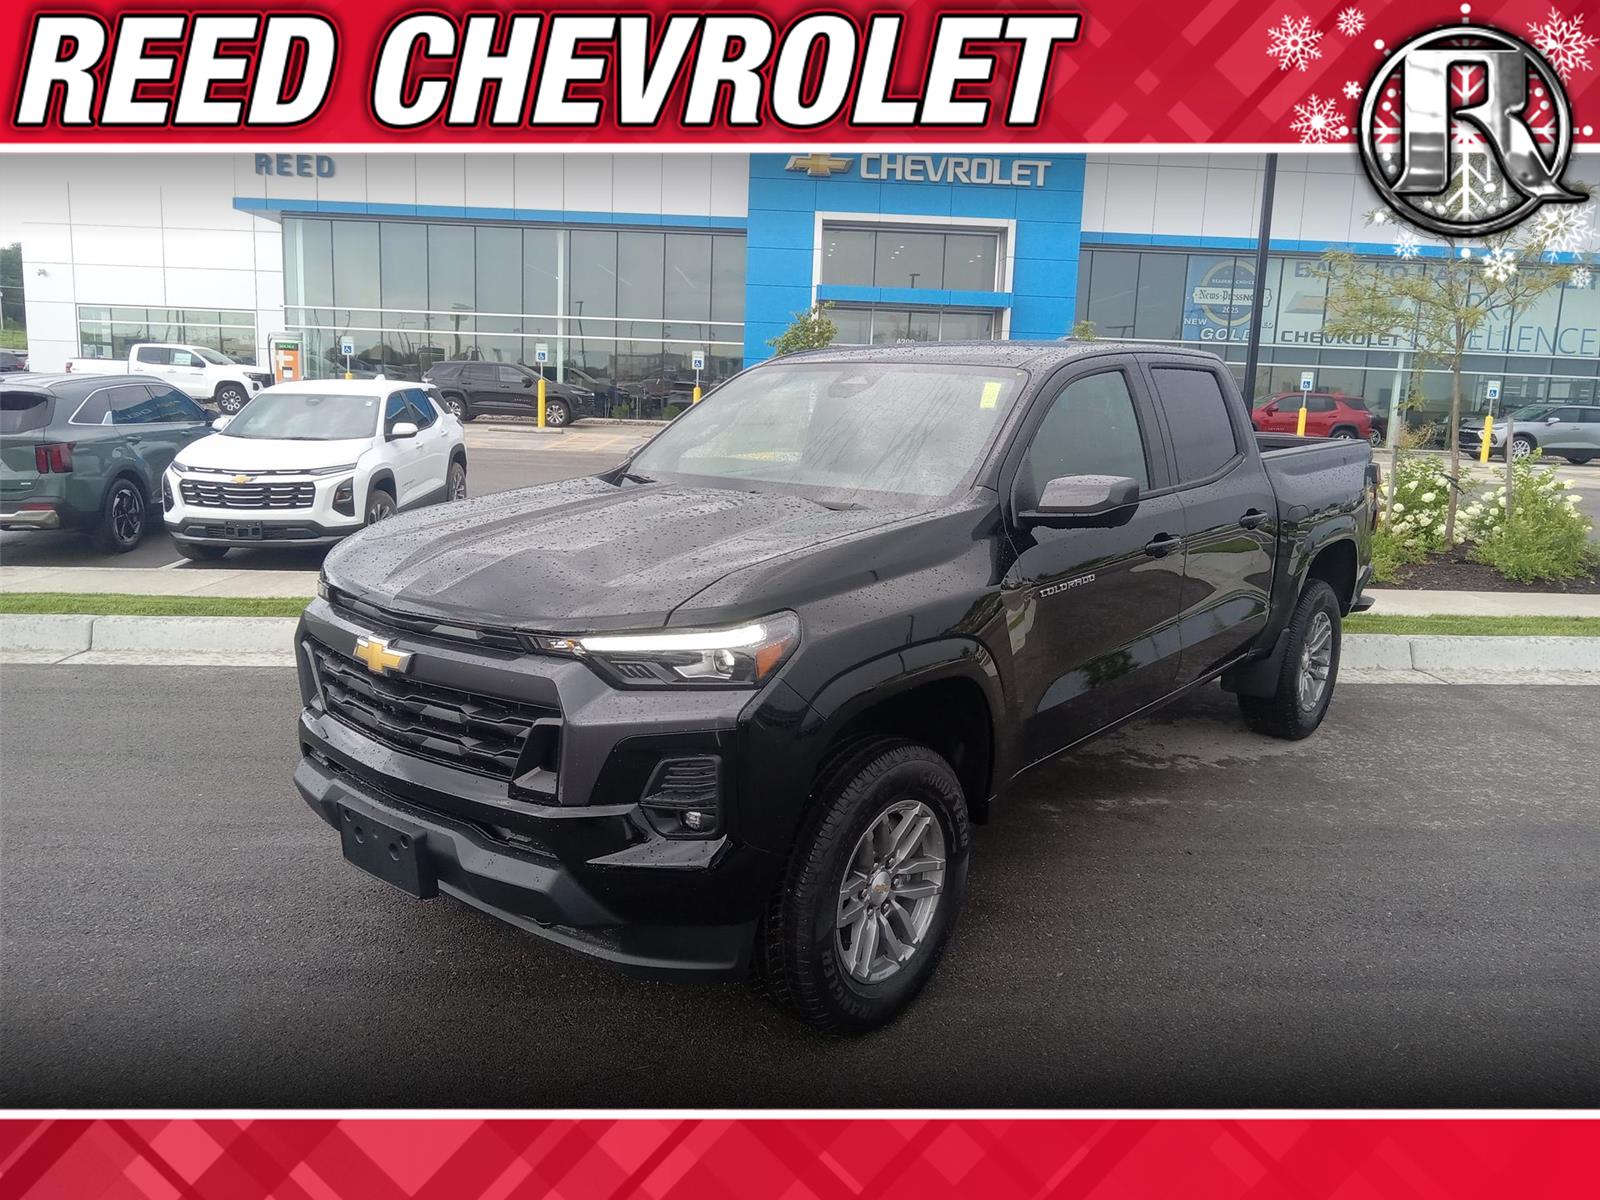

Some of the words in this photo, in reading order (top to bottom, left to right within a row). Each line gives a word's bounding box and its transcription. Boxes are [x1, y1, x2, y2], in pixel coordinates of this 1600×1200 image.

[254, 152, 336, 178] REED
[860, 153, 1052, 187] CHEVROLET
[1183, 317, 1208, 326] NEW
[1280, 329, 1400, 348] CHEVROLET
[1039, 573, 1096, 598] COLORADO
